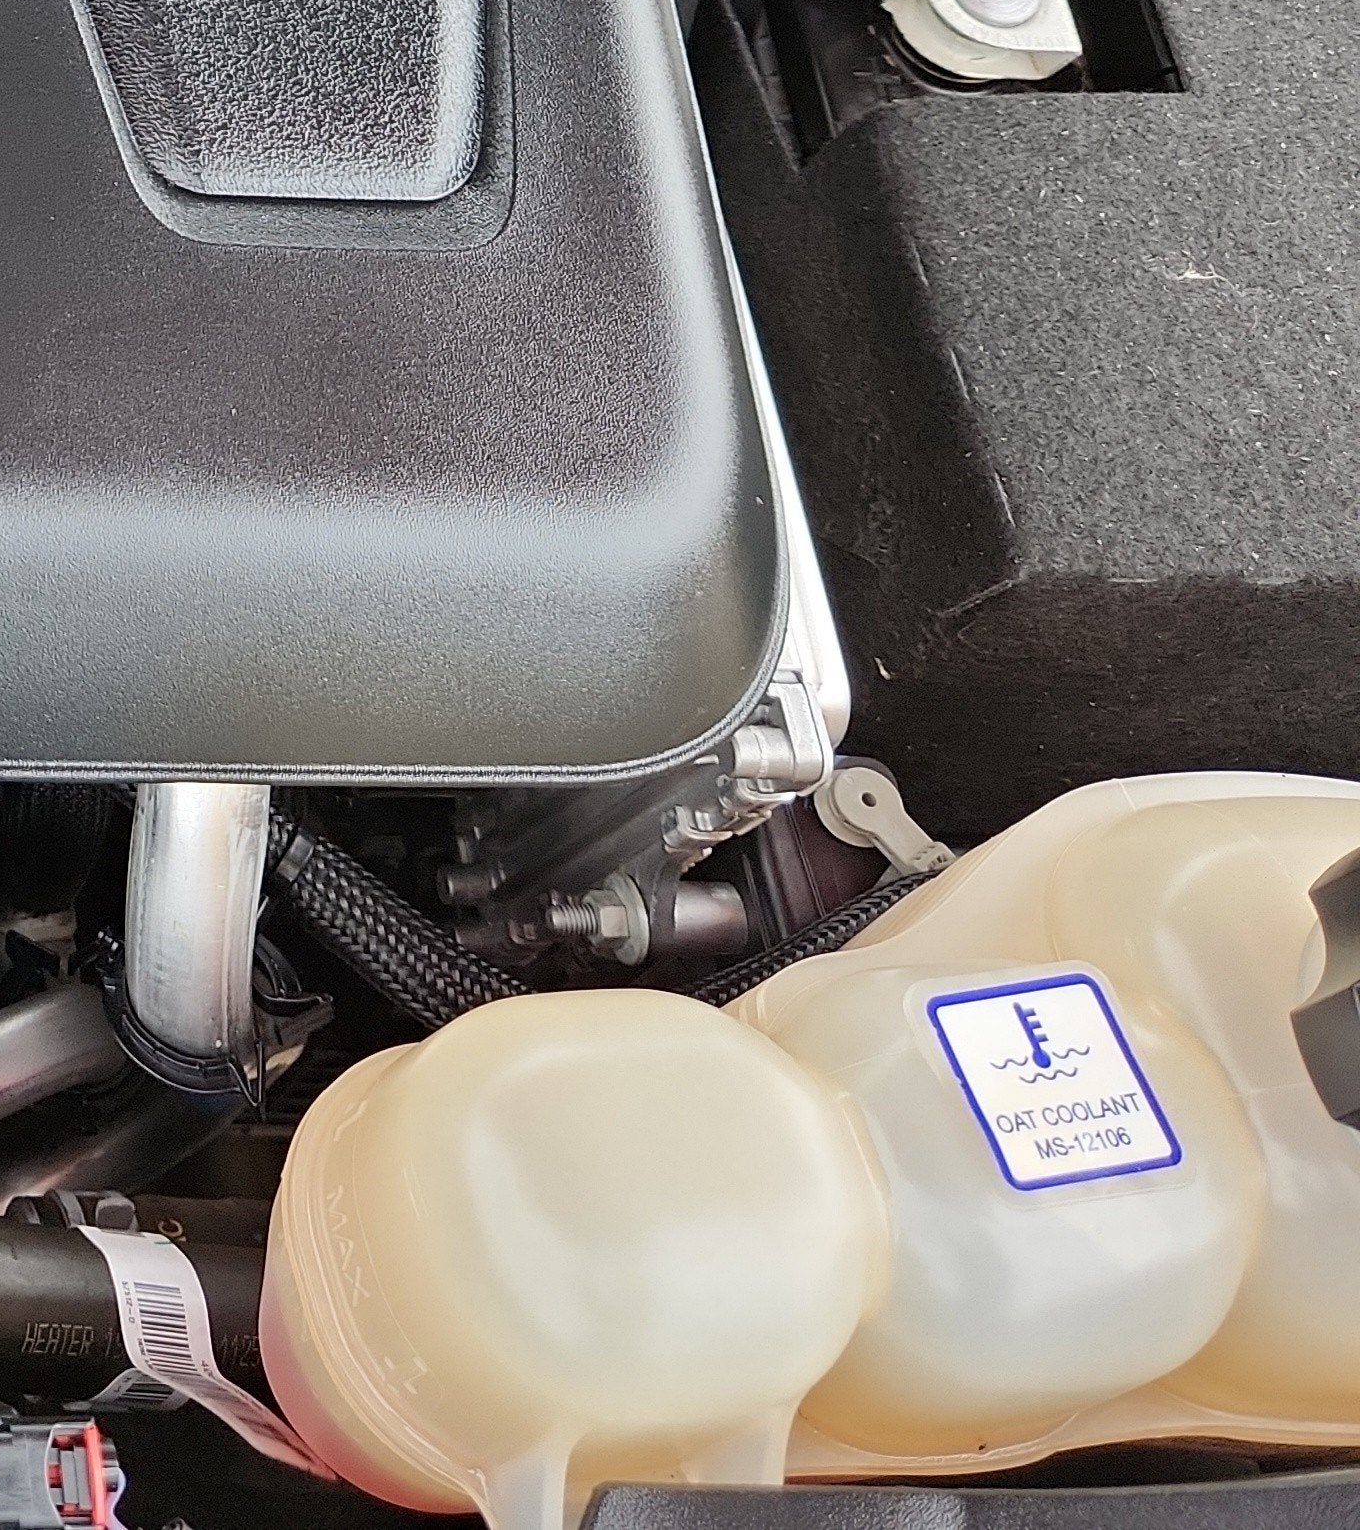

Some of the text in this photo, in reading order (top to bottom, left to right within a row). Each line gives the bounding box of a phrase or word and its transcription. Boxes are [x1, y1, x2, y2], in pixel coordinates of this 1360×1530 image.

[996, 1092, 1141, 1134] OAT COOLANT
[1034, 1126, 1132, 1160] MS-12106
[20, 1322, 95, 1357] HEATER
